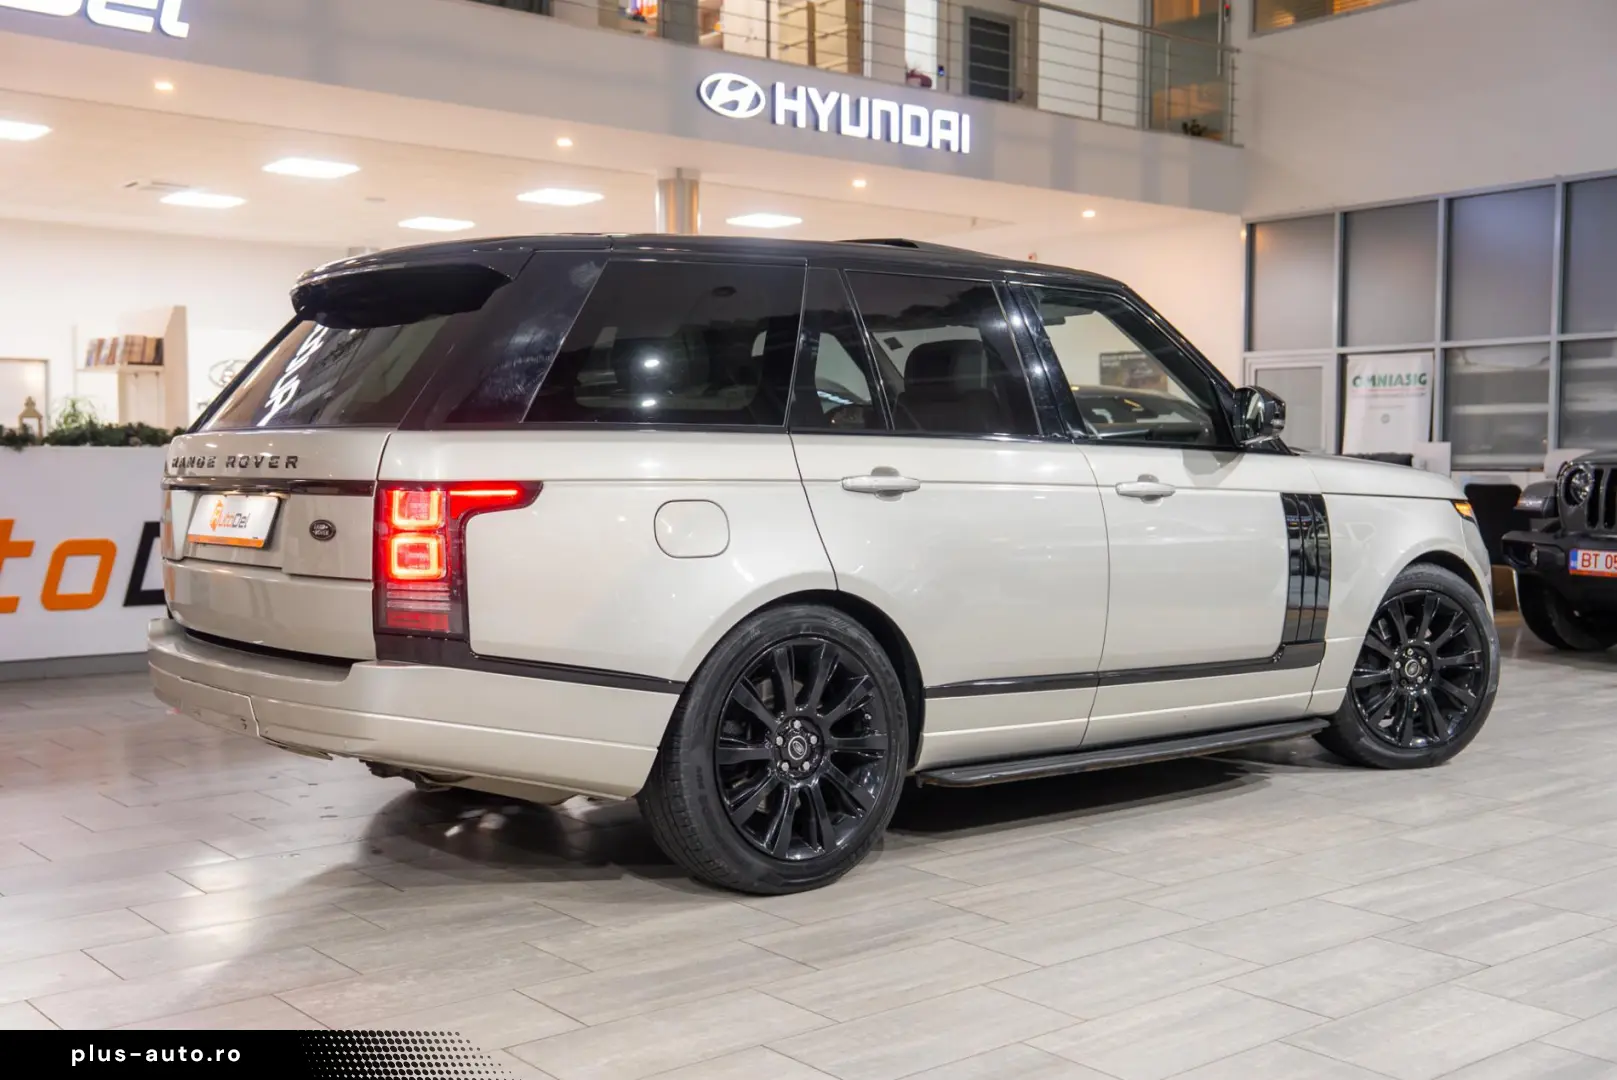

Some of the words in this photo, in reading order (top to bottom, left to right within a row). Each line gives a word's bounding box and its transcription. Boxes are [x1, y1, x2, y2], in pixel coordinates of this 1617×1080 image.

[774, 81, 971, 154] HYUNDAI
[171, 455, 217, 469] RANGE
[225, 455, 299, 469] ROVER
[1581, 552, 1600, 568] BT
